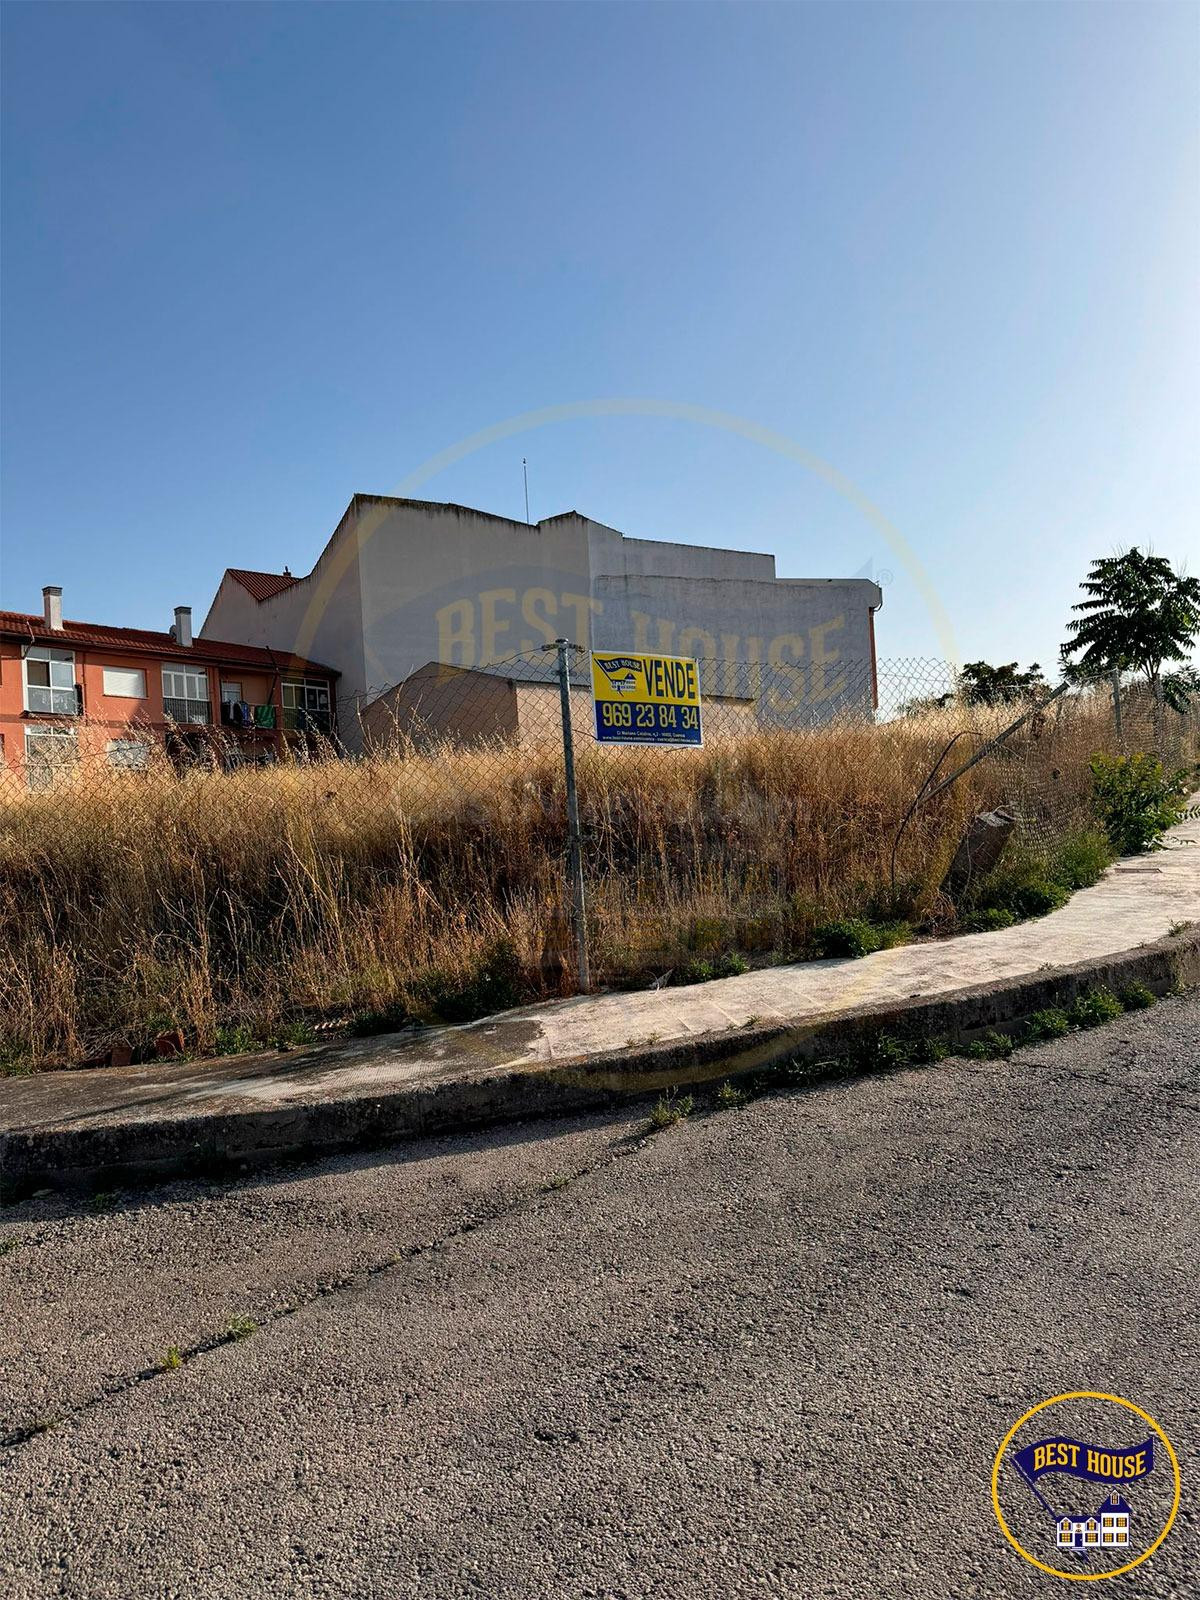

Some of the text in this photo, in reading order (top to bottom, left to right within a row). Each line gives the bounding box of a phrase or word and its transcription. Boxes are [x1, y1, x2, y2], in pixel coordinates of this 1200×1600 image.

[604, 660, 620, 669] BEST
[642, 659, 696, 699] VENDE
[602, 702, 699, 730] 969 23 84 34
